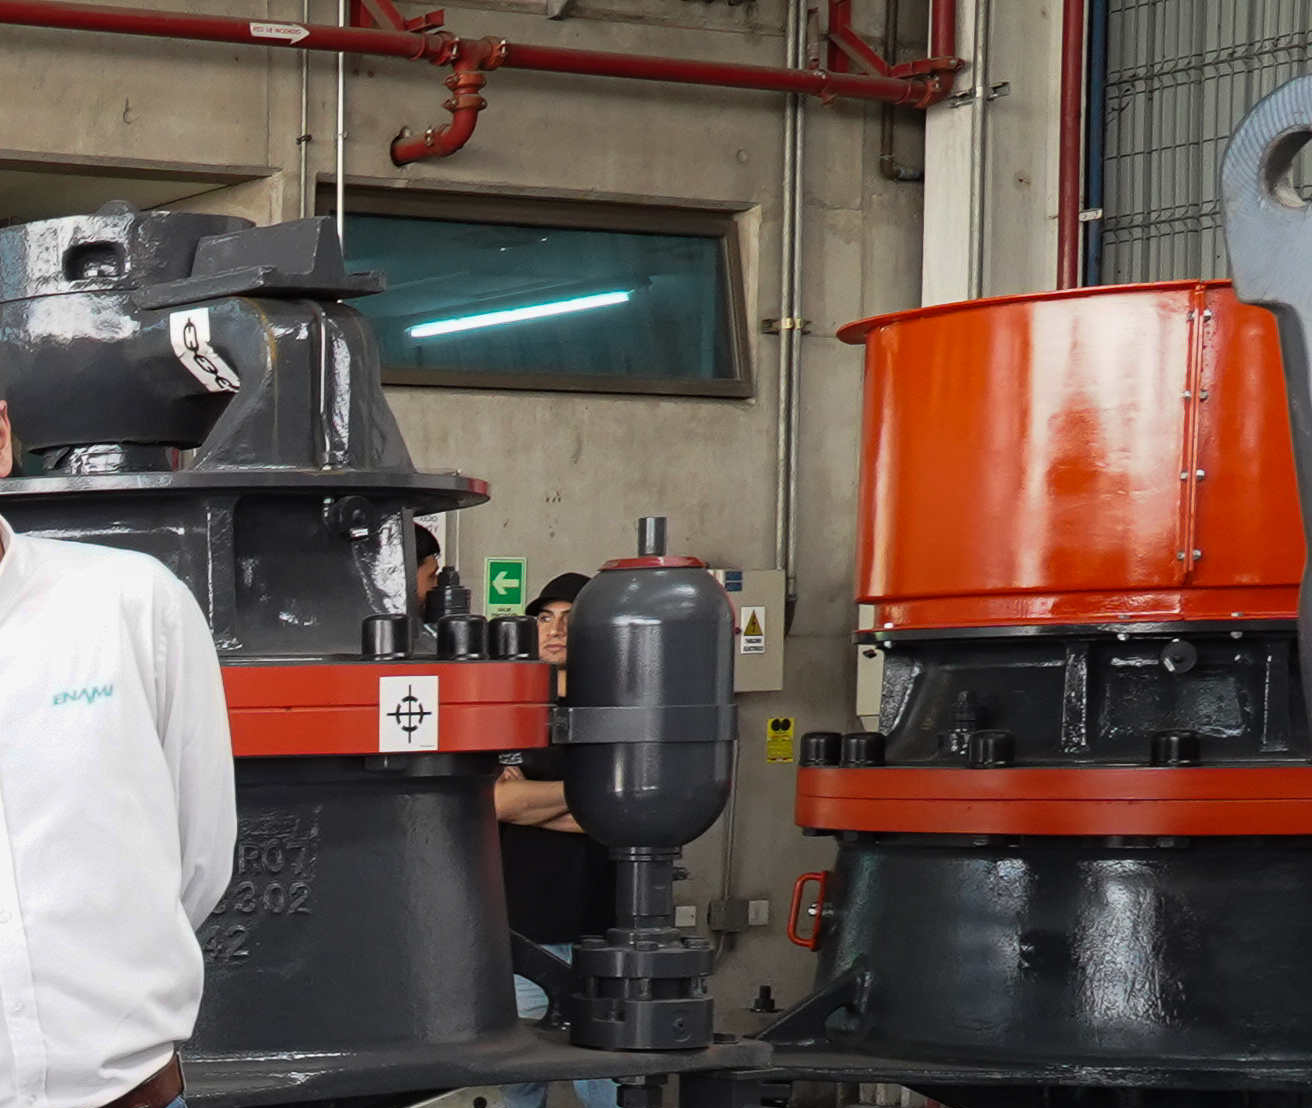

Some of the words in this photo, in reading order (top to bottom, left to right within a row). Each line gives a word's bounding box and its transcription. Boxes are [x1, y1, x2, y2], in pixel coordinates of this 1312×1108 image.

[53, 683, 114, 705] ENAMI
[238, 838, 308, 875] R07
[212, 880, 312, 915] 302
[202, 924, 251, 959] 42
